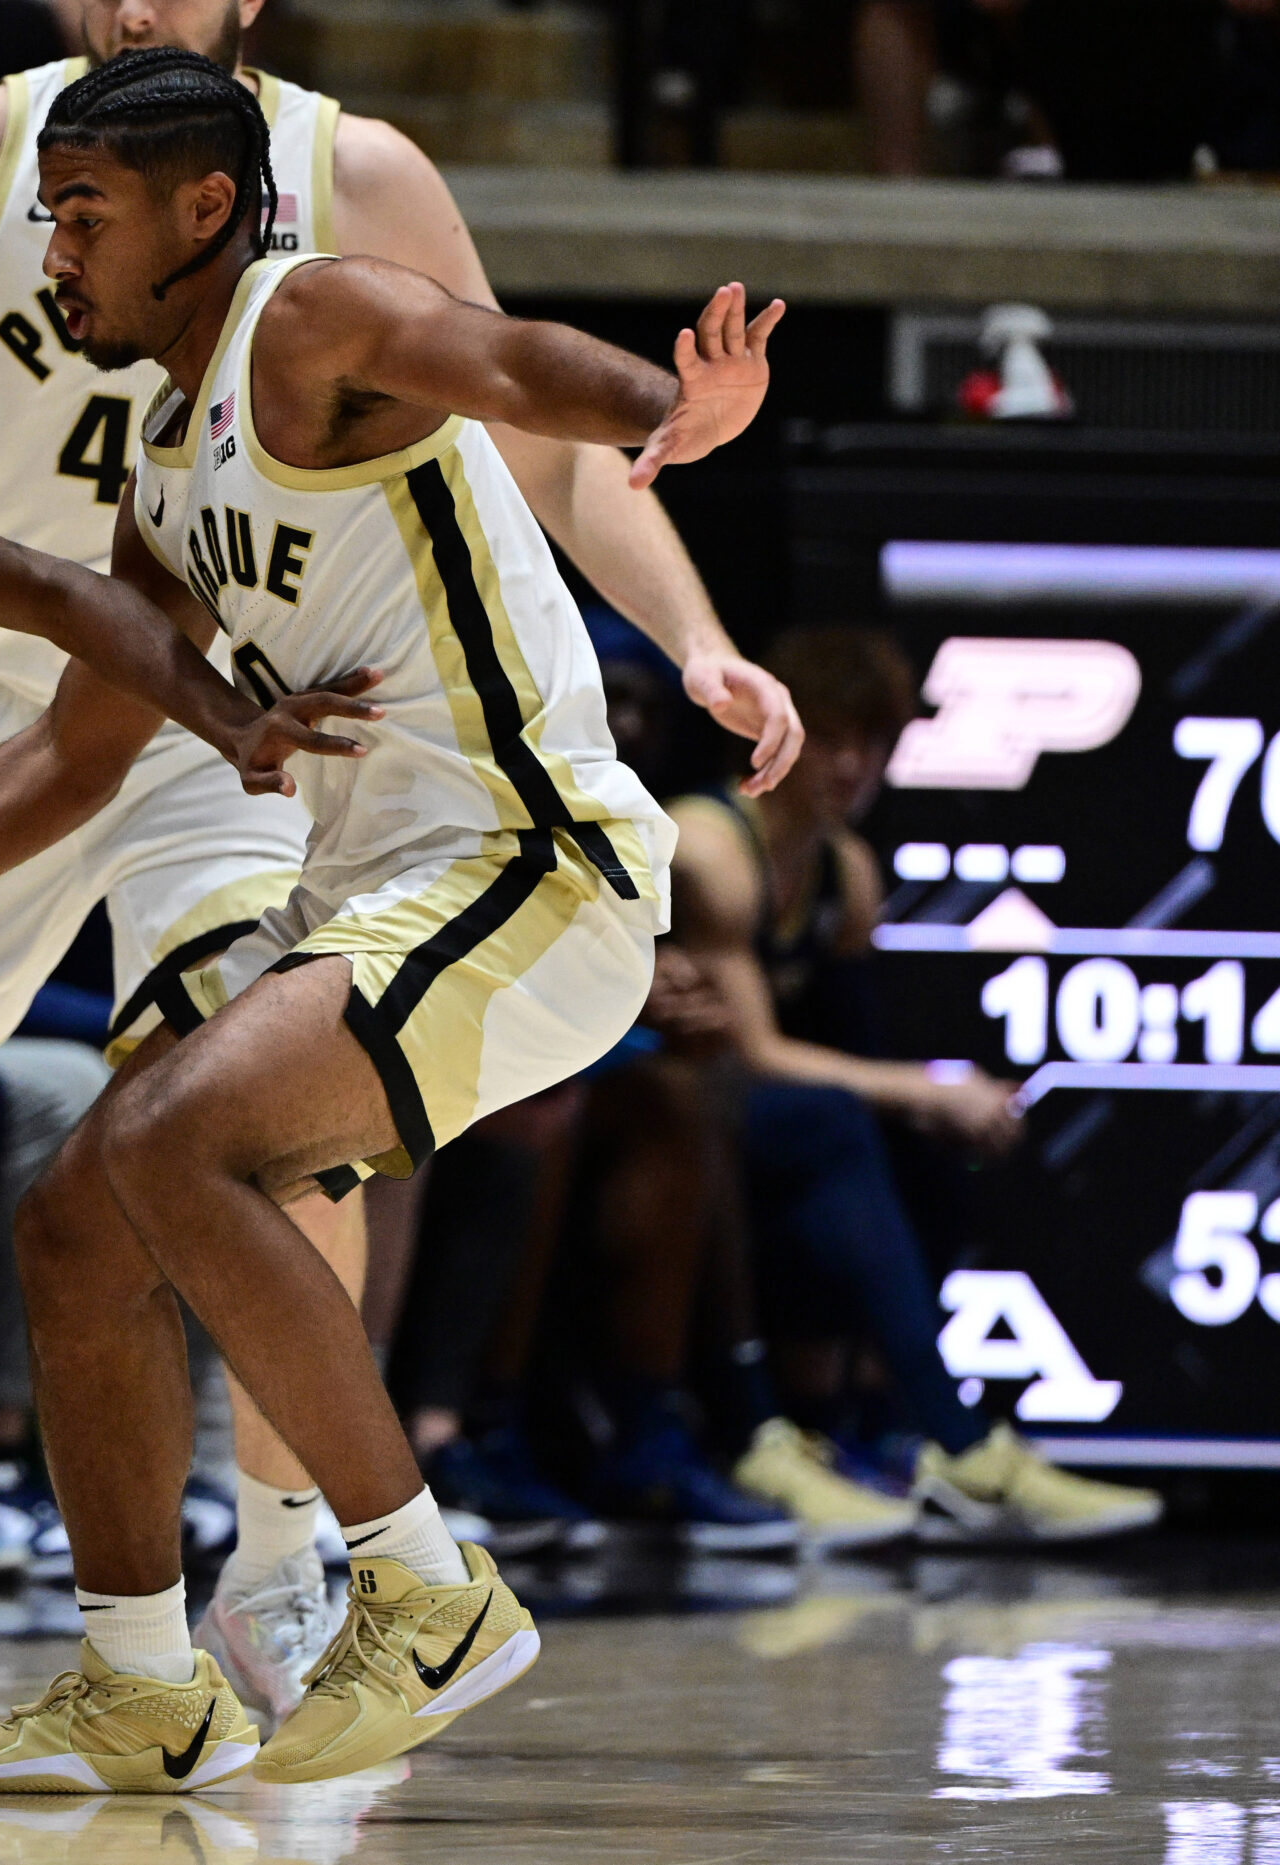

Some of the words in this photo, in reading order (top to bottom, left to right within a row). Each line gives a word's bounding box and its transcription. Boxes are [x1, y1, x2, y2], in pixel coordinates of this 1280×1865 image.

[56, 393, 133, 505] 4
[885, 636, 1143, 791] P
[1173, 716, 1280, 852] 7
[1170, 1190, 1280, 1327] 5
